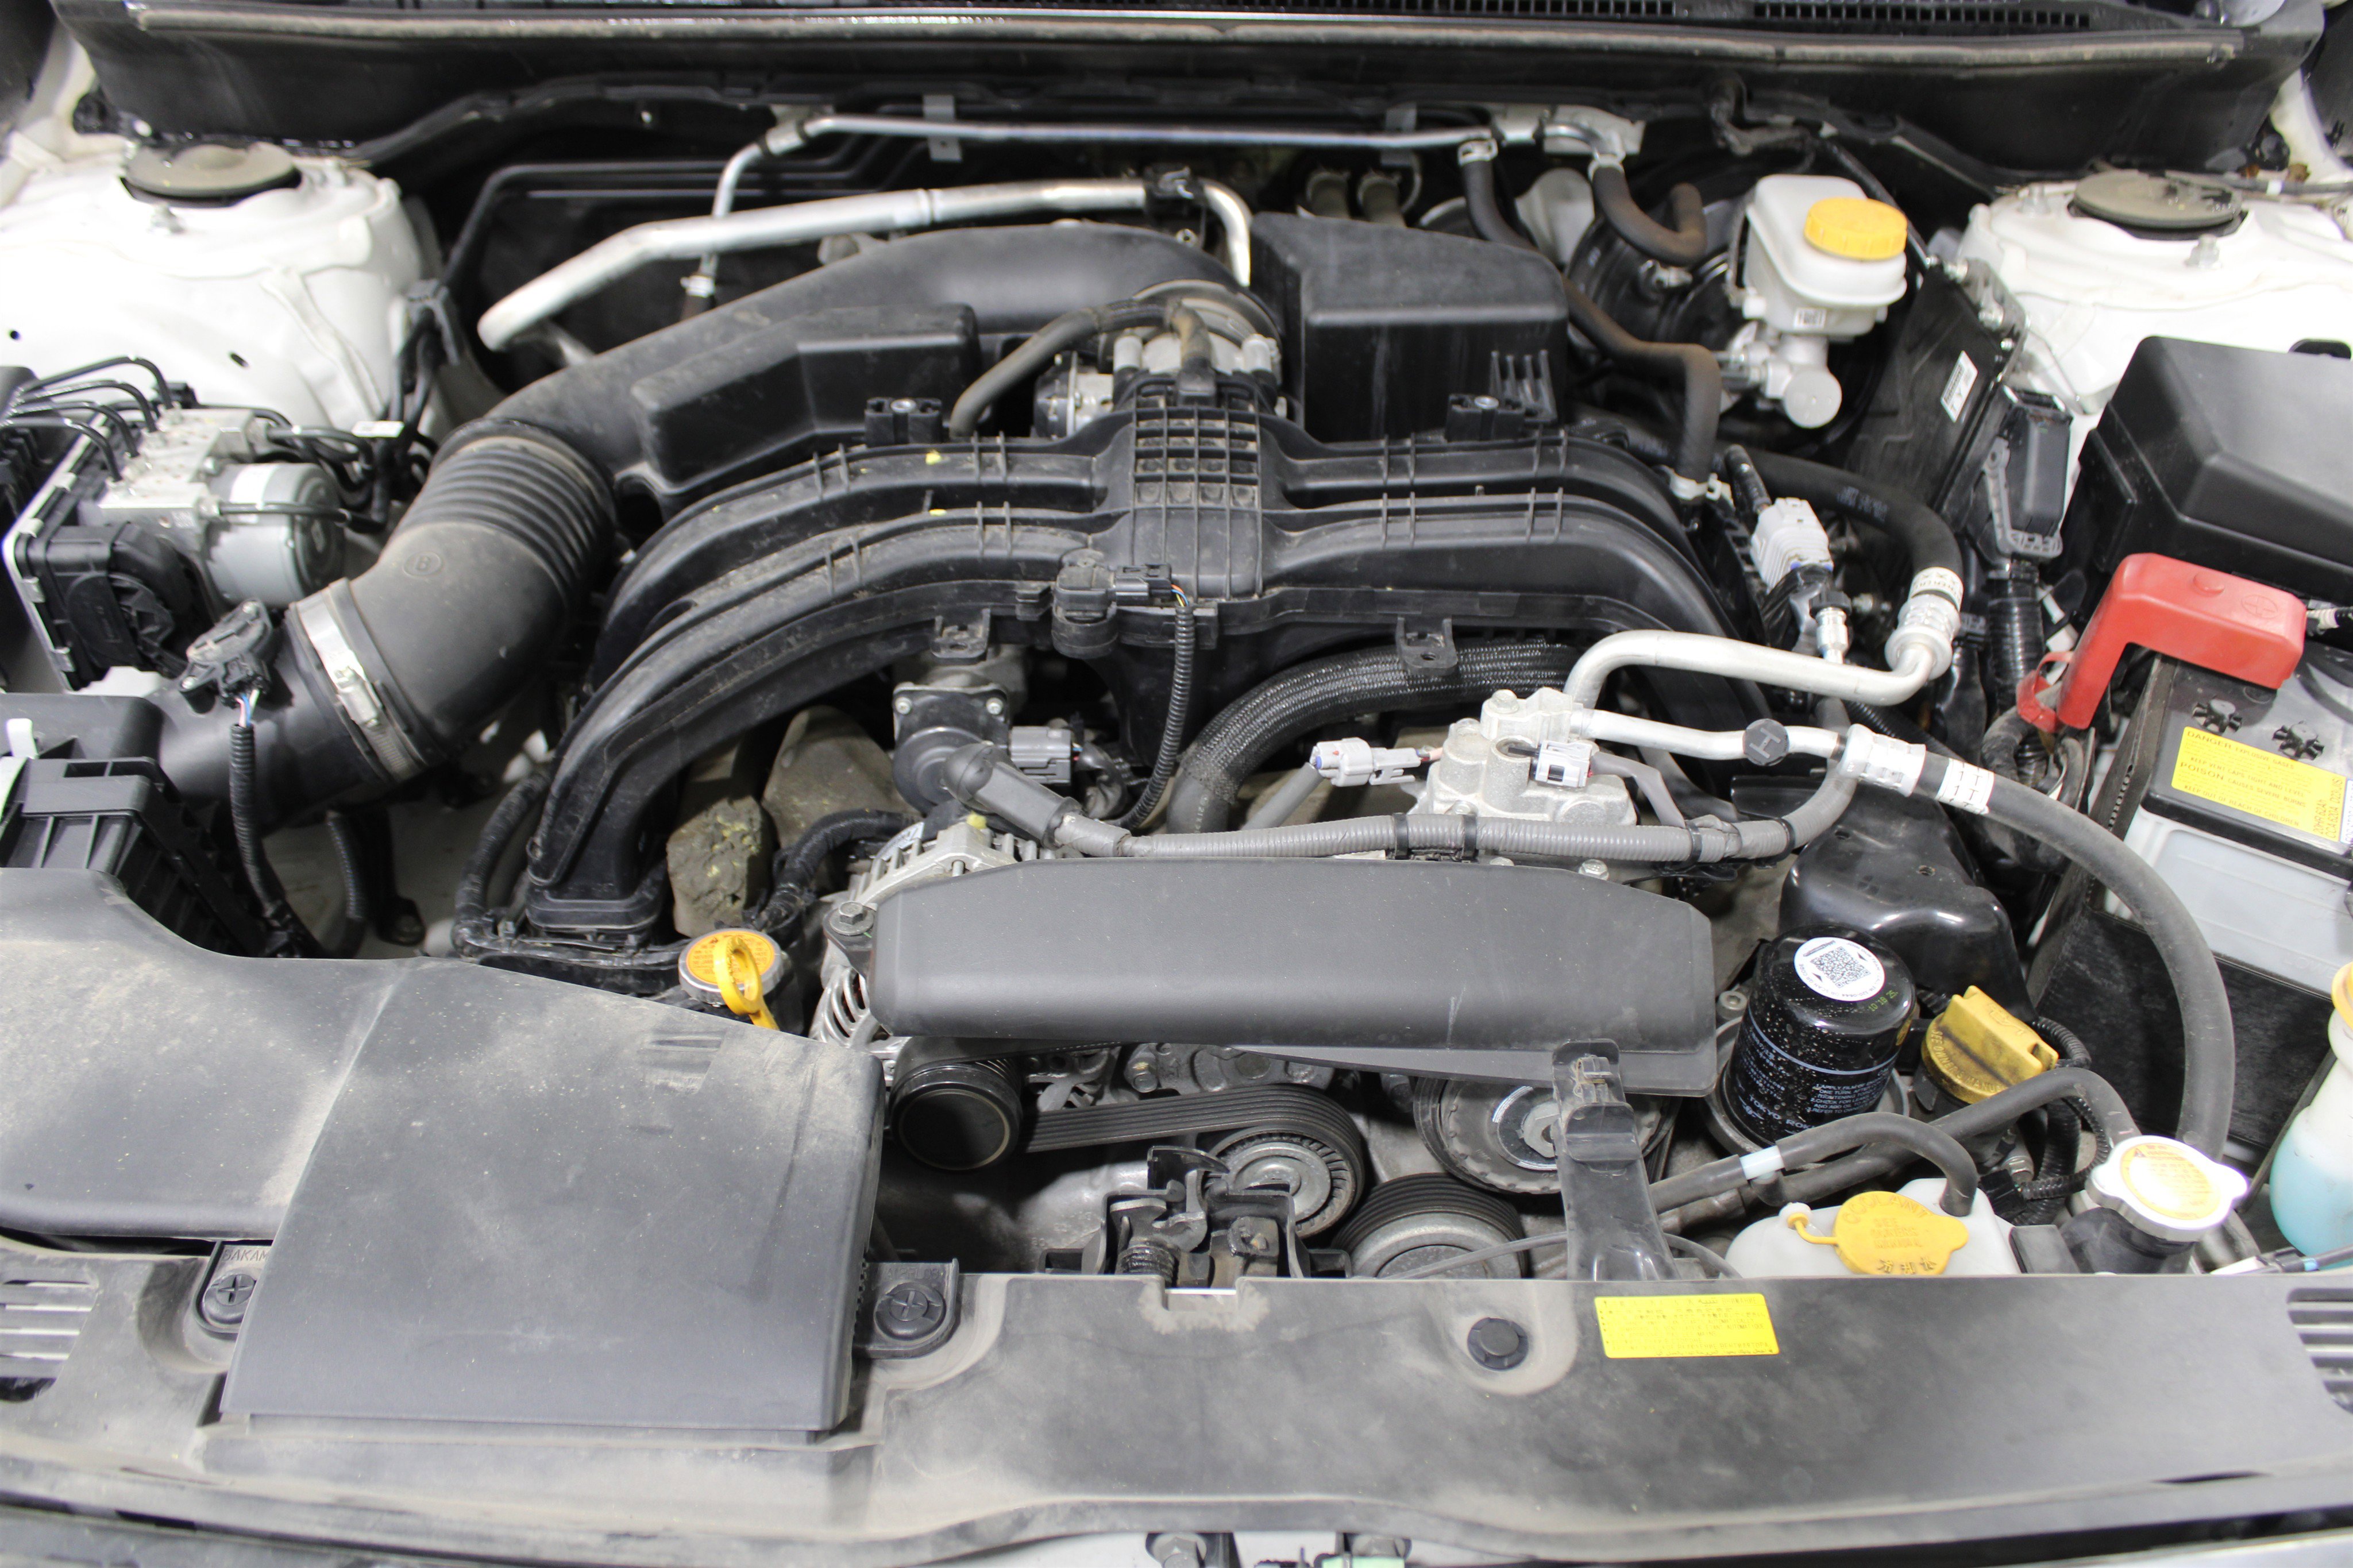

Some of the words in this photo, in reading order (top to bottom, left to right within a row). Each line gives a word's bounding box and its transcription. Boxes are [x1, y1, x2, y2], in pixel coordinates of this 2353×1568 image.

[1749, 727, 1781, 759] H
[2187, 731, 2232, 750] DANGER
[2235, 747, 2270, 762] EXPLOSIVE
[2273, 758, 2294, 770] GASES
[2180, 761, 2224, 781] POISON
[2228, 778, 2254, 791] CAUSES
[2256, 787, 2281, 799] SEVERE
[2283, 795, 2306, 808] BURNS
[2190, 756, 2208, 765] KEEP
[2209, 762, 2226, 772] VENT
[2228, 768, 2245, 778] CAPS
[2247, 774, 2267, 785] TIGHT
[2269, 781, 2284, 791] AND
[2285, 786, 2305, 798] LEVEL
[2184, 785, 2201, 794] KEEP
[2202, 790, 2216, 799] OUT
[2229, 798, 2252, 811] REACH
[2253, 806, 2262, 814] OF
[2264, 810, 2300, 827] CHILDREN
[1868, 1002, 1879, 1012] 10
[1877, 996, 1888, 1006] 18
[1930, 1029, 1944, 1045] SEE
[1749, 1094, 1782, 1120] TOKYO
[1842, 1194, 1930, 1225] COOLANT
[1873, 1217, 1899, 1228] SEE
